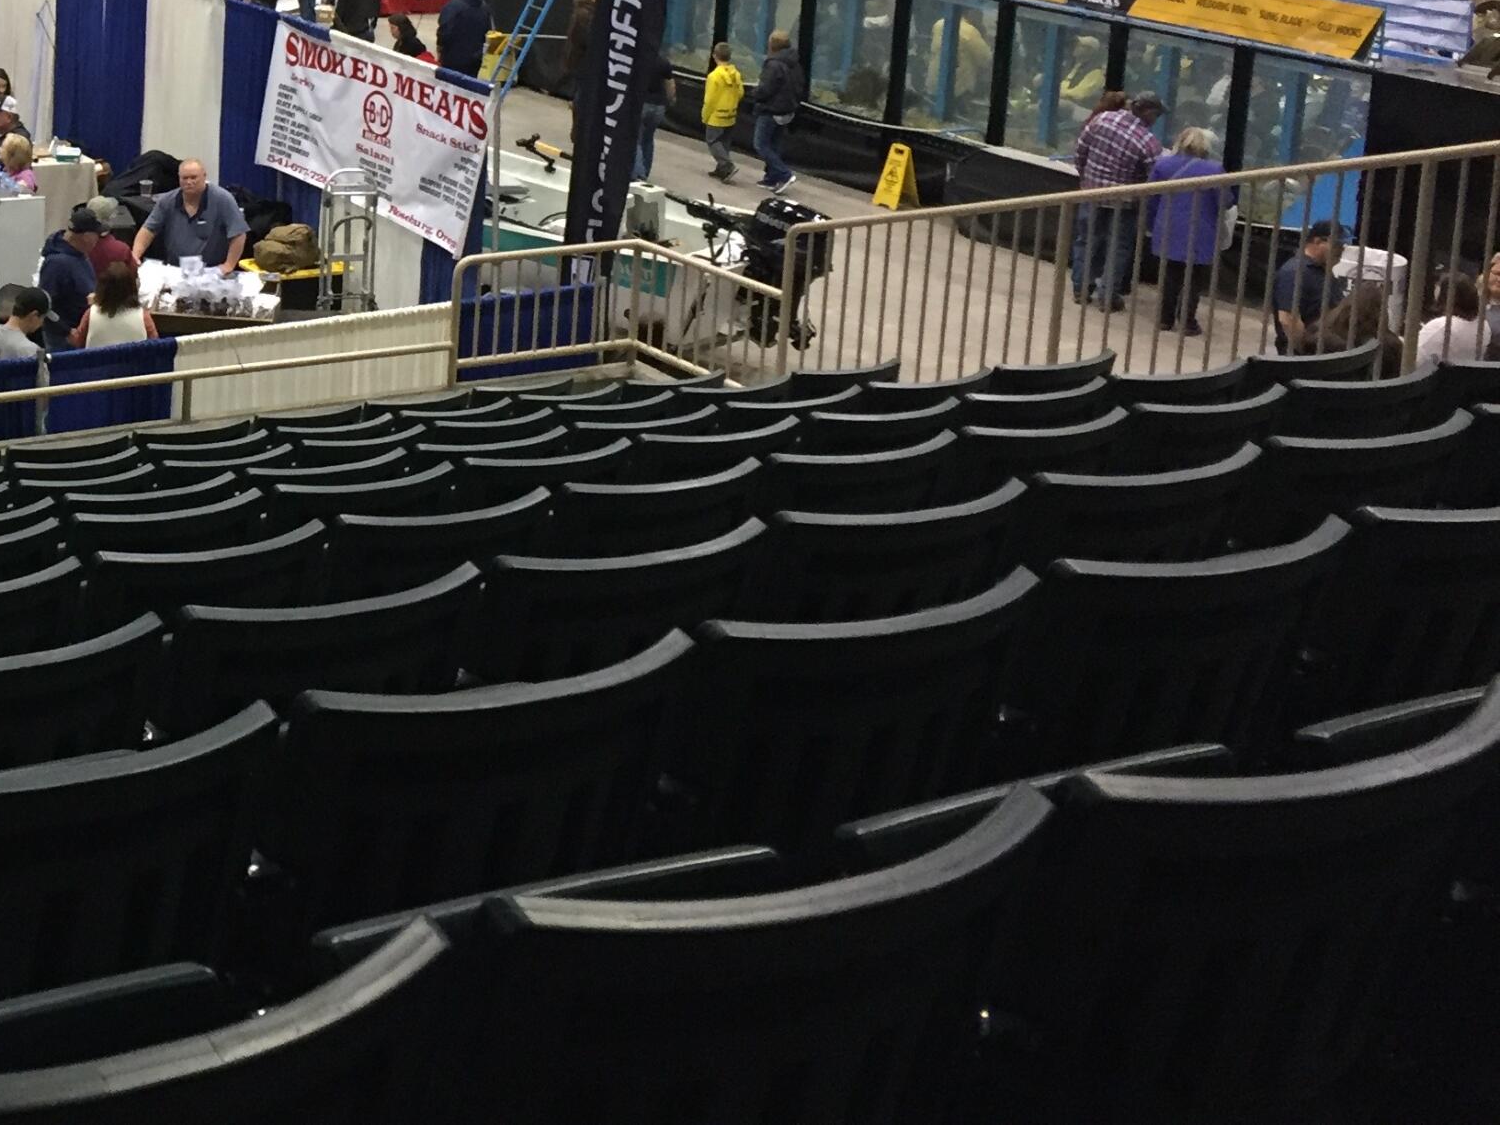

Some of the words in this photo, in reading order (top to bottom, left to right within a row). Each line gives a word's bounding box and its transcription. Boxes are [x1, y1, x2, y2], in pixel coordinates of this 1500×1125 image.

[285, 31, 388, 89] SMOKED
[393, 72, 488, 141] MEATS
[416, 123, 447, 145] Snack
[355, 143, 396, 166] Salami
